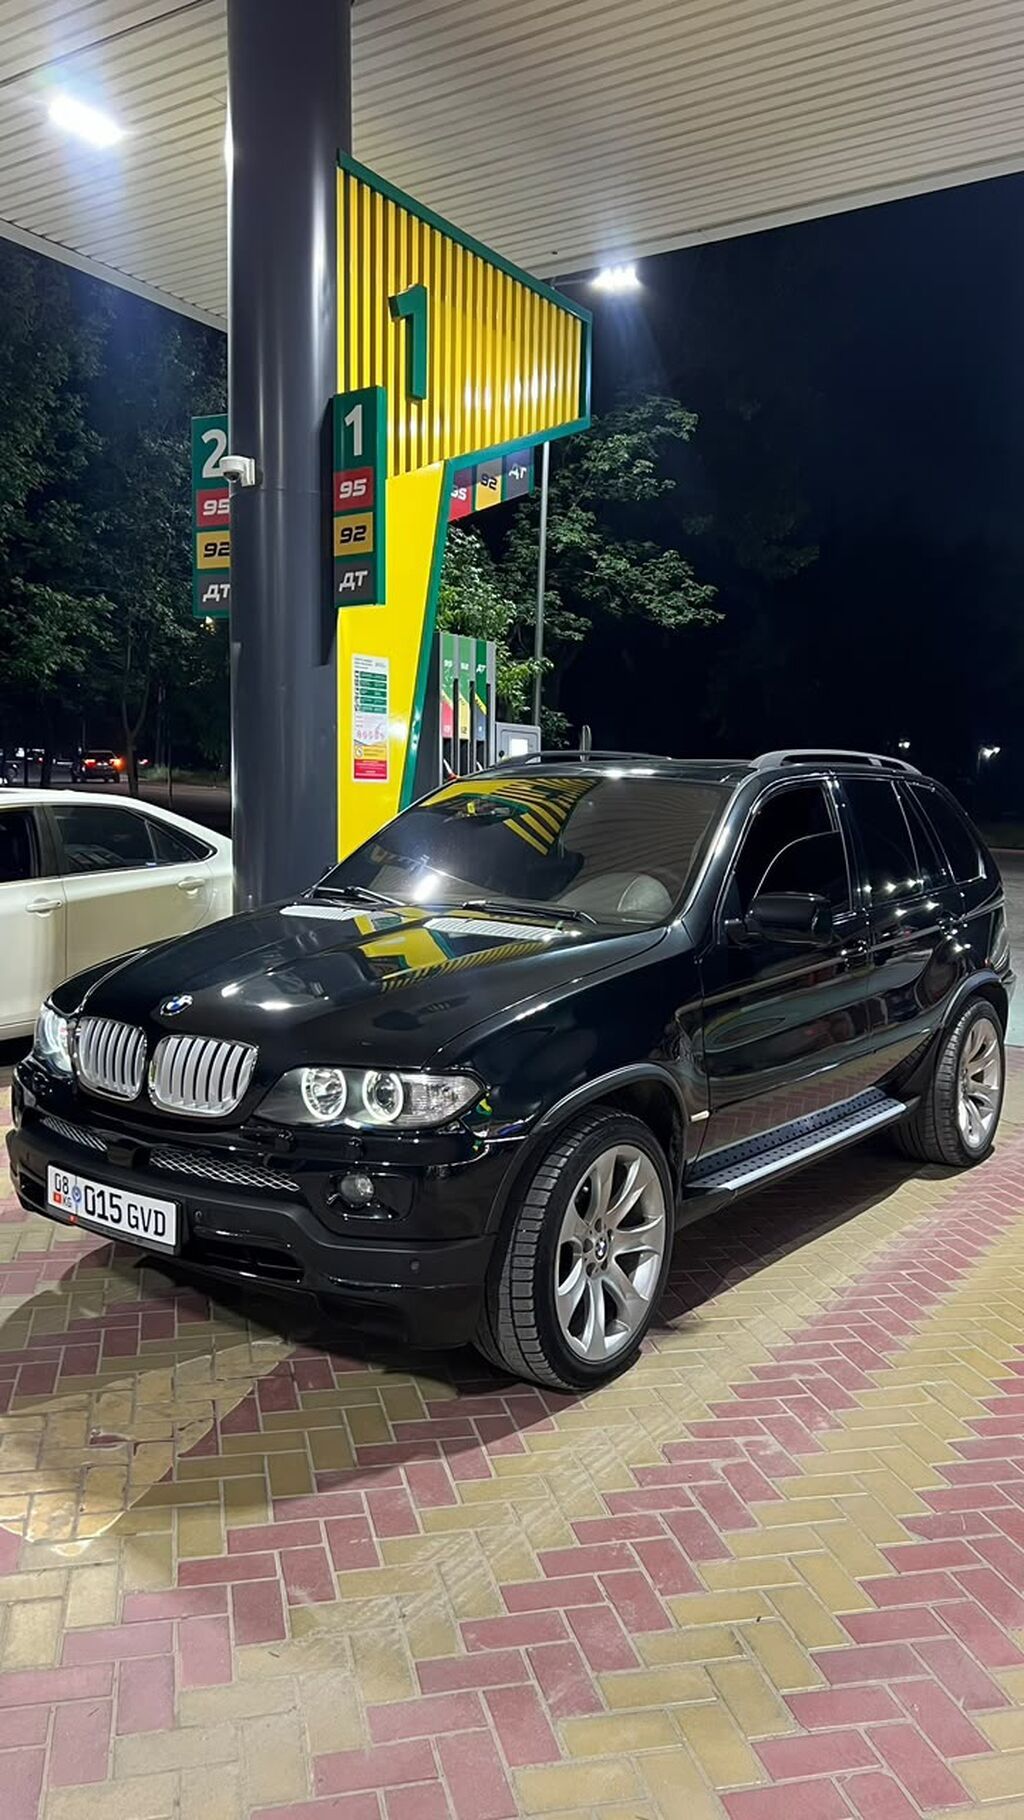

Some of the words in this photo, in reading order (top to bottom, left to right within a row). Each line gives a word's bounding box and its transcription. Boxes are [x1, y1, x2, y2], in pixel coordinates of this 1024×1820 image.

[388, 284, 428, 400] 1
[344, 404, 363, 457] 1
[201, 429, 228, 478] 2
[339, 478, 367, 499] 95
[481, 473, 497, 491] 92
[203, 499, 230, 516] 95
[340, 525, 367, 544] 92
[203, 541, 230, 558] 92
[339, 570, 368, 592] ДТ
[202, 583, 230, 602] ДТ
[55, 1173, 69, 1194] 08
[84, 1185, 122, 1224] 015
[127, 1203, 166, 1237] GVD
